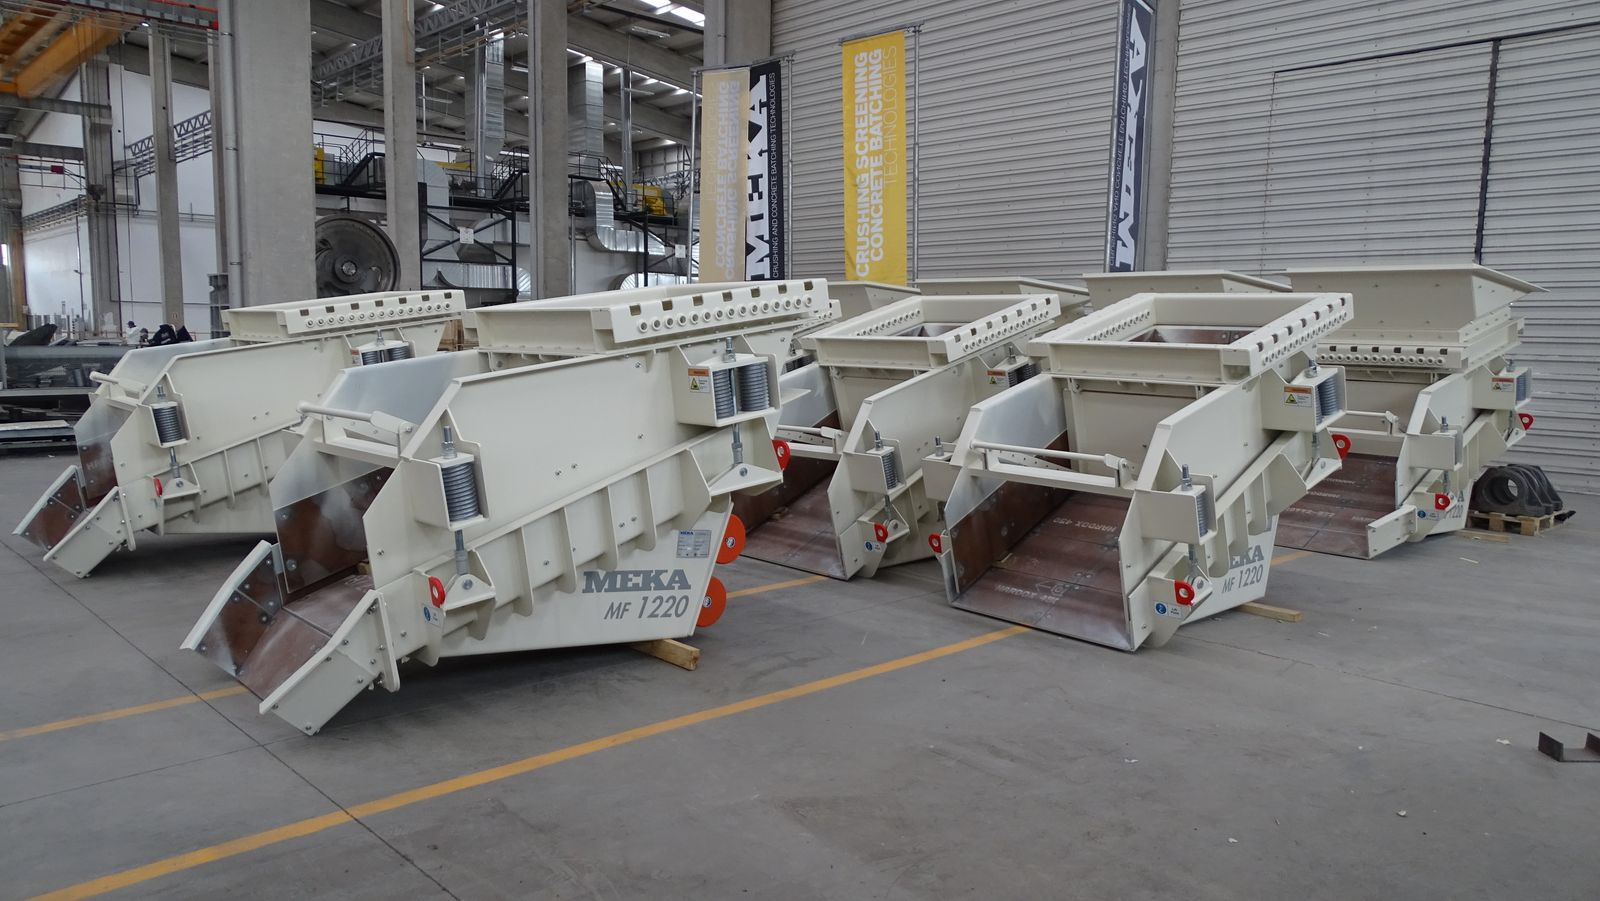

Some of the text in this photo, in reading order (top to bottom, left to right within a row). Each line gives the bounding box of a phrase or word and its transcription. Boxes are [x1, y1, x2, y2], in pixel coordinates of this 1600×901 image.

[768, 72, 776, 135] TECHNOLOGIES
[882, 45, 897, 186] TECHNOLOGIES
[854, 51, 870, 277] CRUSHING SCREENING
[868, 48, 884, 261] CONCRETE BATCHING
[746, 75, 770, 281] MEKA
[770, 175, 778, 217] CONCRETE
[771, 238, 779, 279] CRUSHING
[1229, 544, 1264, 570] EKA
[582, 568, 692, 594] MEKA
[1221, 564, 1264, 594] MF 1220
[603, 594, 690, 620] MF 1220
